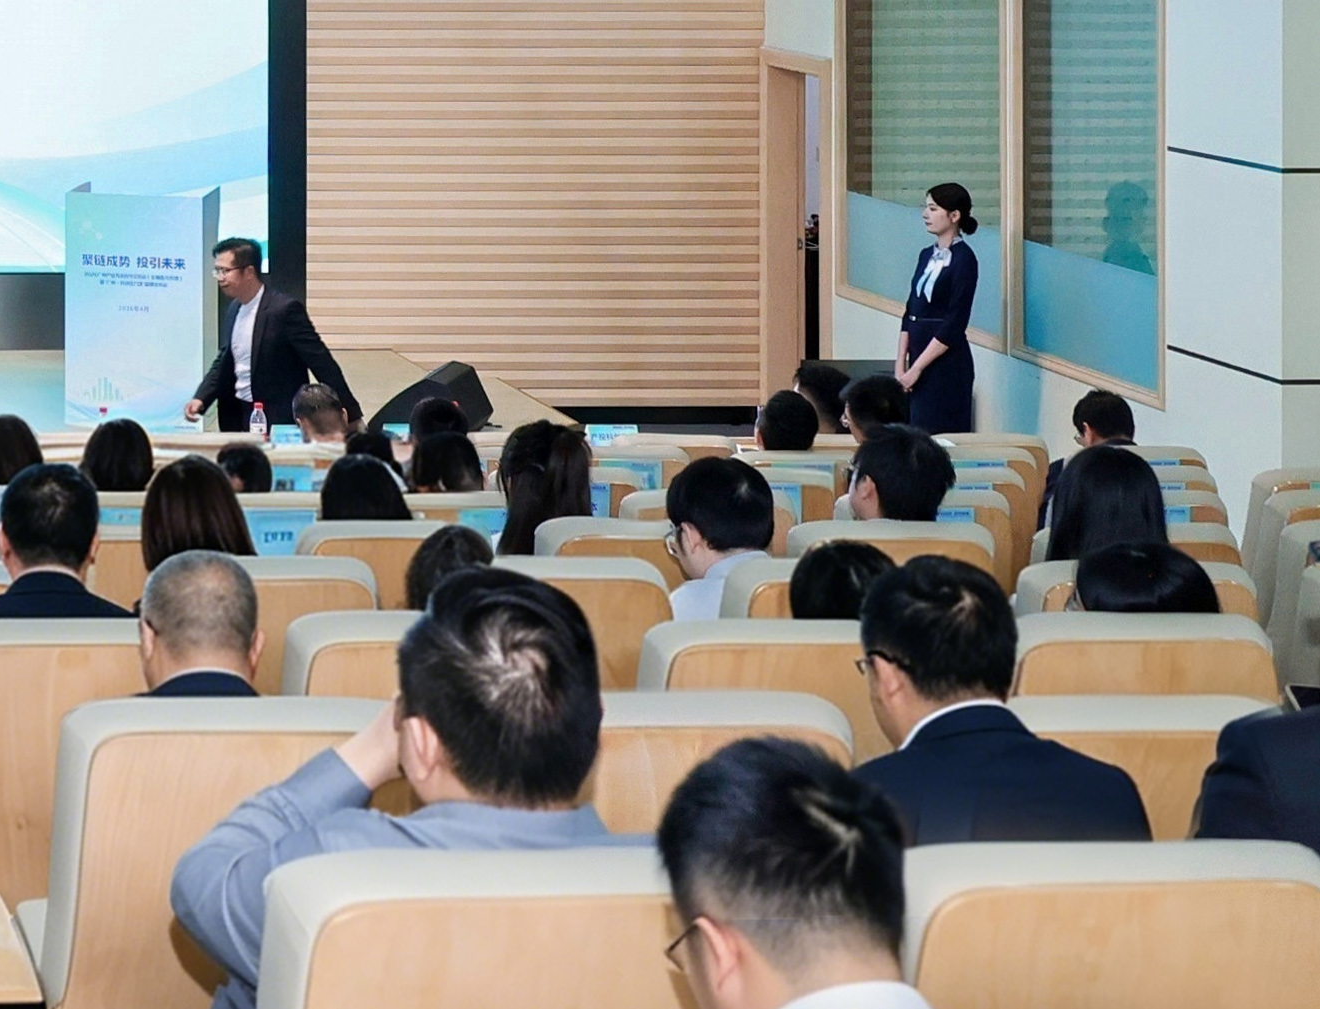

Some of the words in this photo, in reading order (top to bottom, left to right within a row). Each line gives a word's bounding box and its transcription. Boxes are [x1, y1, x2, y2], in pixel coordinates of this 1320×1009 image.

[82, 253, 131, 268] 聚链成势
[136, 256, 186, 271] 投引未来
